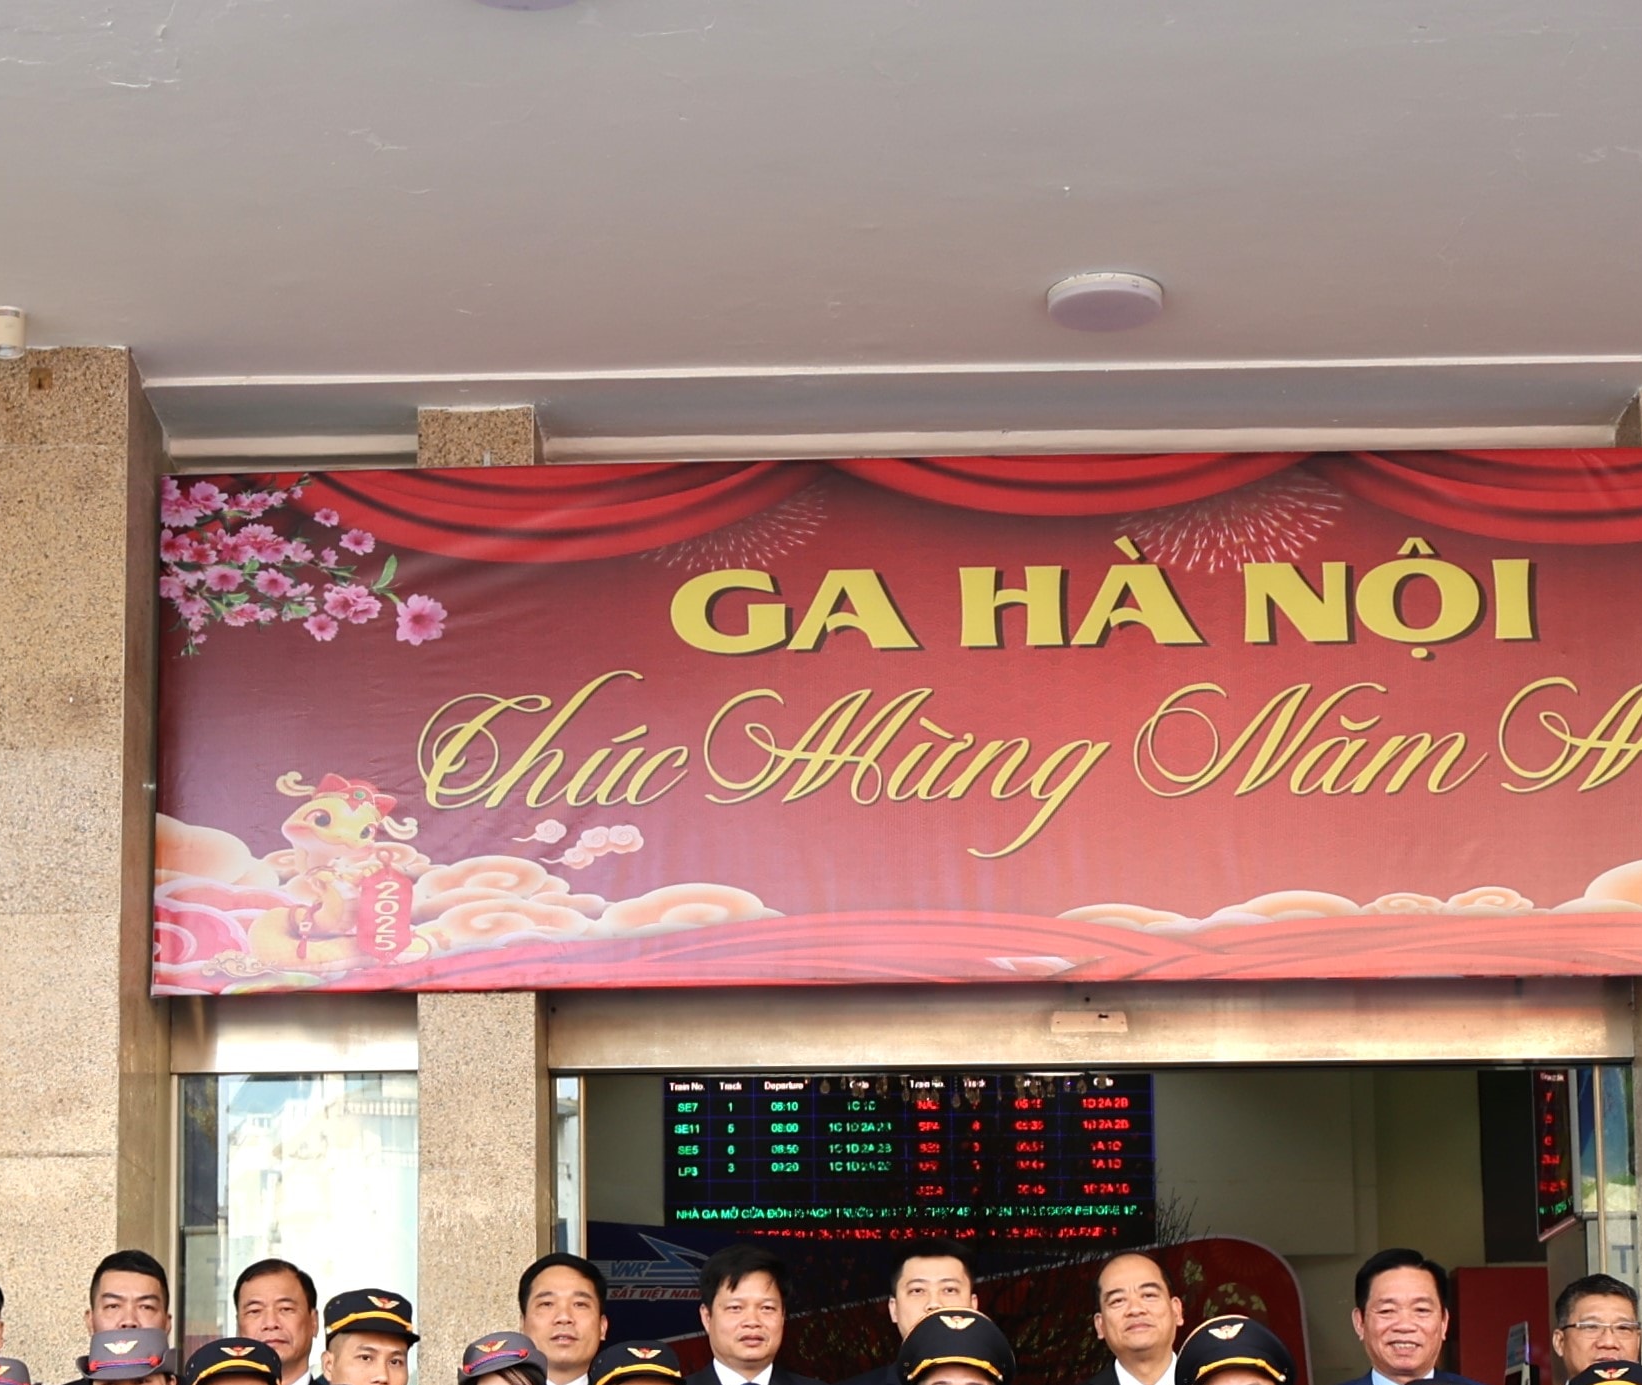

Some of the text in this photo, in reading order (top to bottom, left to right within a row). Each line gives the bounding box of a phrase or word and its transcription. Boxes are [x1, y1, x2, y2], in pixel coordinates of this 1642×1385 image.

[670, 536, 1533, 658] GA HÀ NỘI
[417, 670, 690, 809] Chúc
[704, 687, 1110, 859] Mừng
[1133, 682, 1488, 797] Năm
[374, 881, 400, 951] 2025
[677, 1102, 699, 1112] SE7
[1098, 1097, 1113, 1109] 2A
[674, 1123, 700, 1134] SE11
[861, 1122, 875, 1133] 2A
[677, 1145, 699, 1155] SE5
[846, 1143, 860, 1154] 1D
[678, 1166, 699, 1177] LP3
[676, 1206, 699, 1220] NHÀ
[701, 1208, 719, 1219] GA
[610, 1261, 649, 1277] VNR
